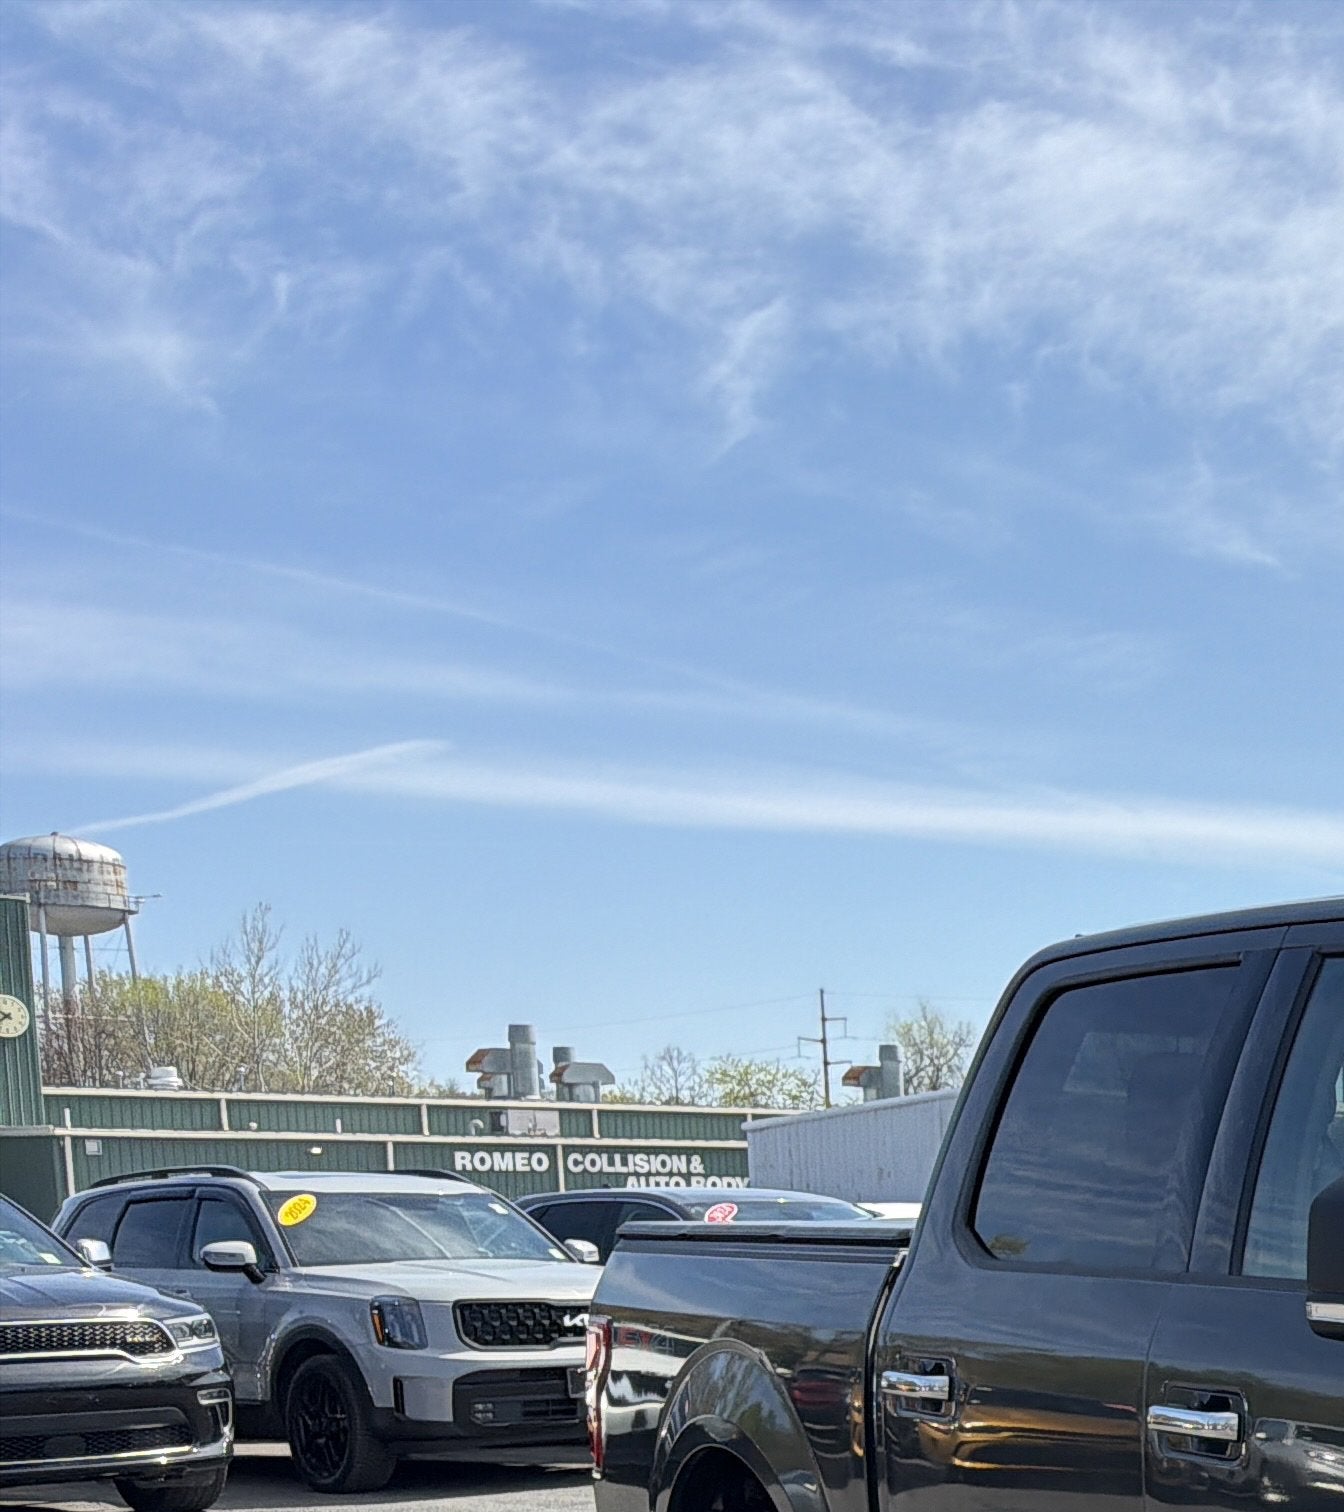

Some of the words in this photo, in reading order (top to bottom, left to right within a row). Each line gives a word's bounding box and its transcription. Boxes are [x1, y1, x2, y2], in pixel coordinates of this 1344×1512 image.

[454, 1151, 549, 1172] ROMEO
[567, 1152, 688, 1174] COLLISION
[689, 1154, 706, 1175] &
